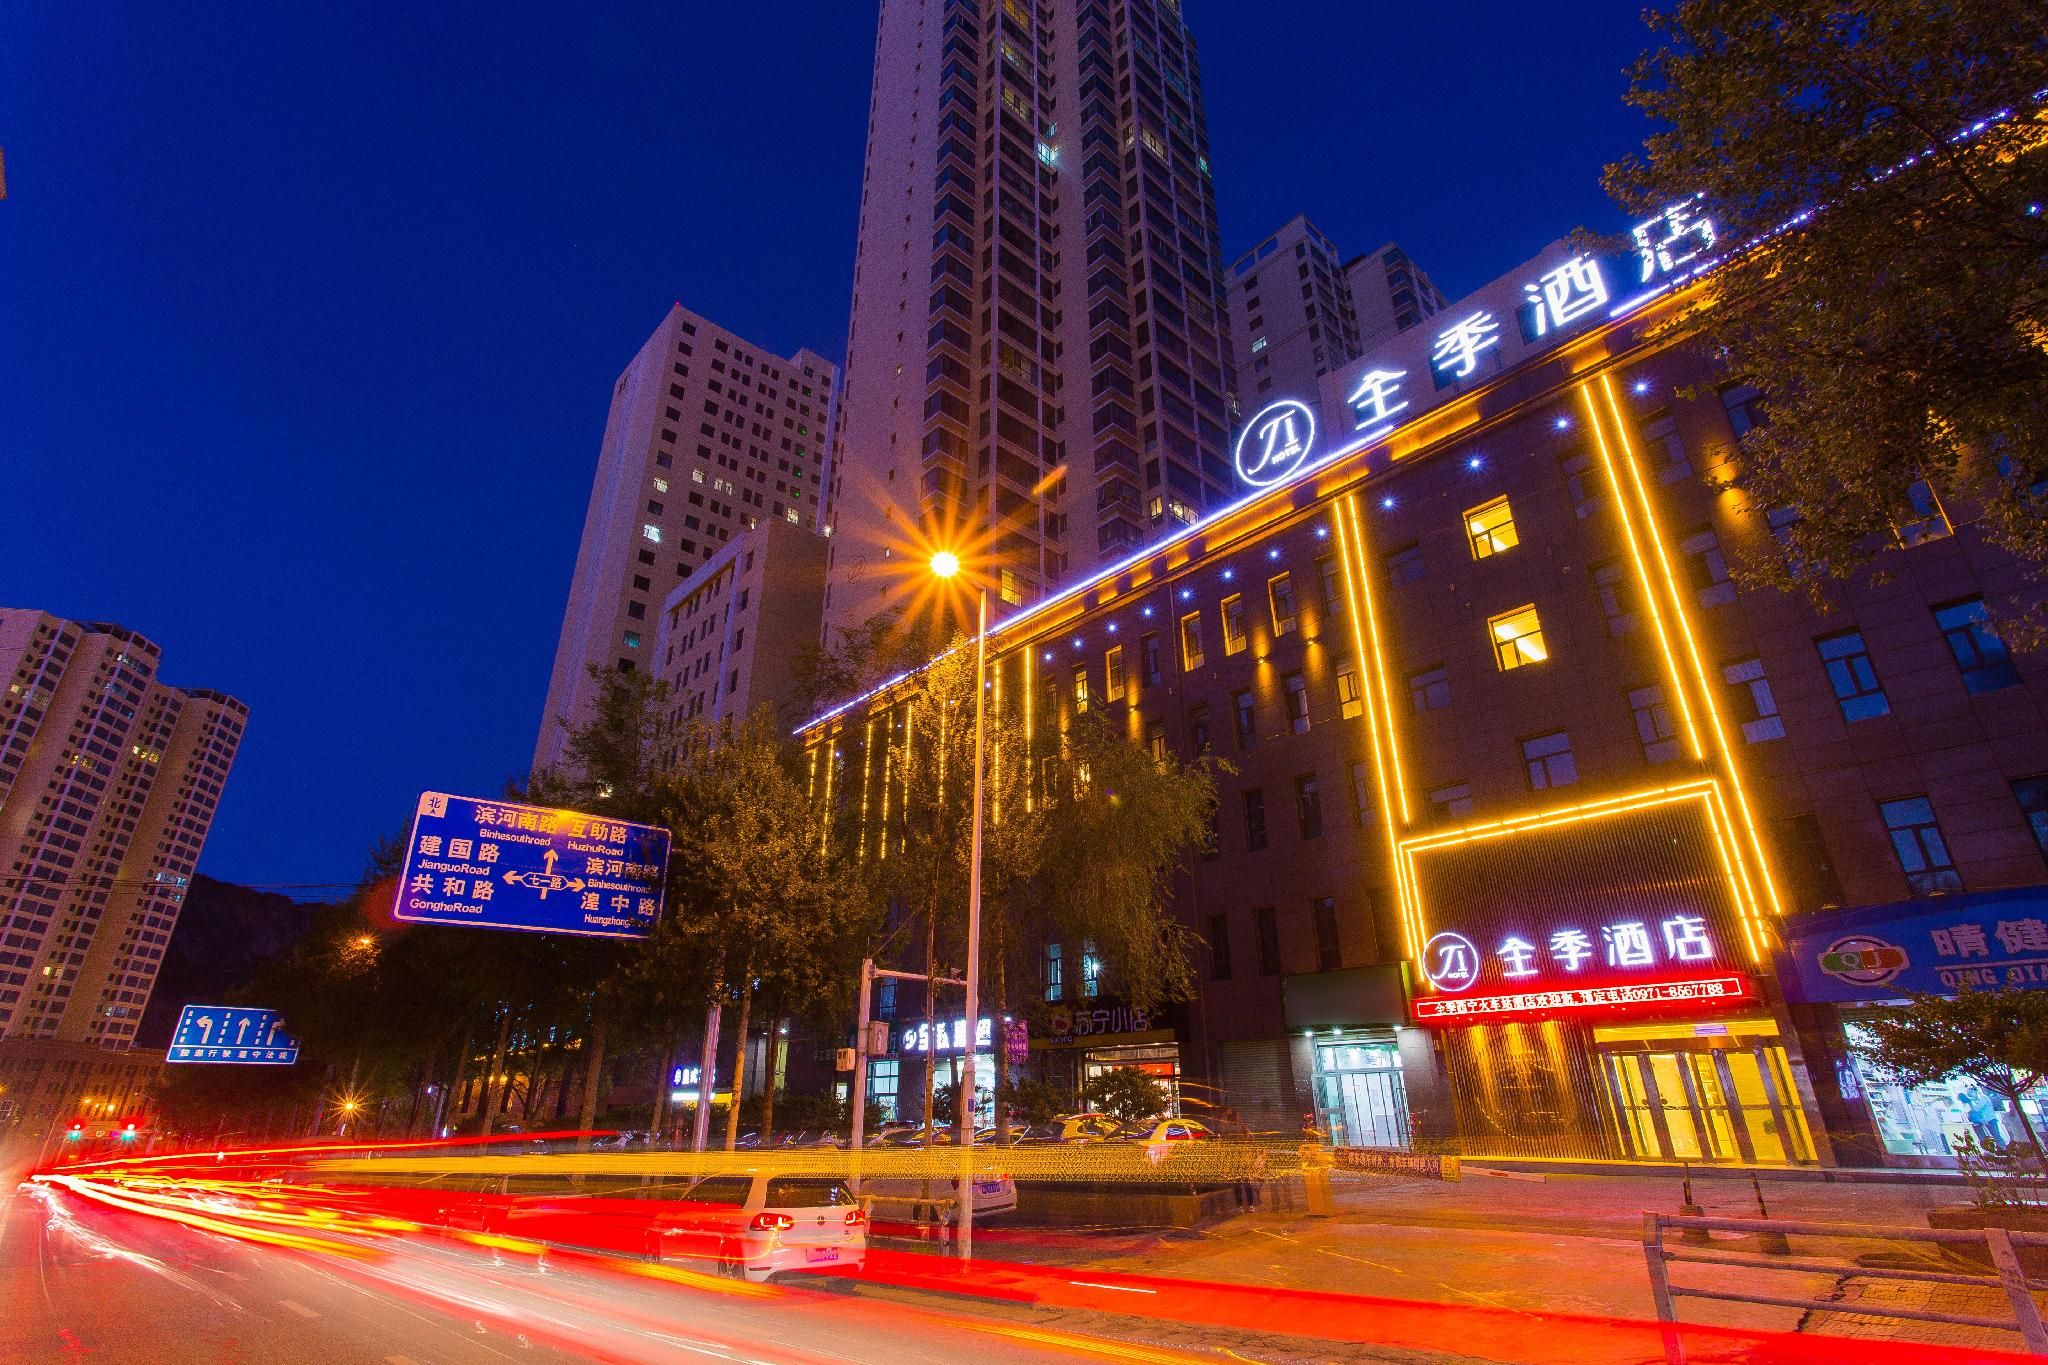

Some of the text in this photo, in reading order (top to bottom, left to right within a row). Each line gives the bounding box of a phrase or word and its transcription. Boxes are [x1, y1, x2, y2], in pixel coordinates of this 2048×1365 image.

[1347, 191, 1717, 430] 全季酒店
[428, 797, 441, 809] 北
[474, 804, 628, 844] 滨河南路 互助路
[418, 835, 500, 863] 建国路
[479, 828, 624, 857] Binhesouthroad HuzhuRoad
[418, 859, 490, 876] JianguoRoad
[528, 874, 562, 889] 七一路
[410, 873, 495, 901] 共和路
[409, 898, 483, 914] GongheRoad
[580, 891, 656, 916] 湟中路
[1496, 916, 1713, 977] 全季酒店
[1075, 1006, 1152, 1036] 苏宁小店
